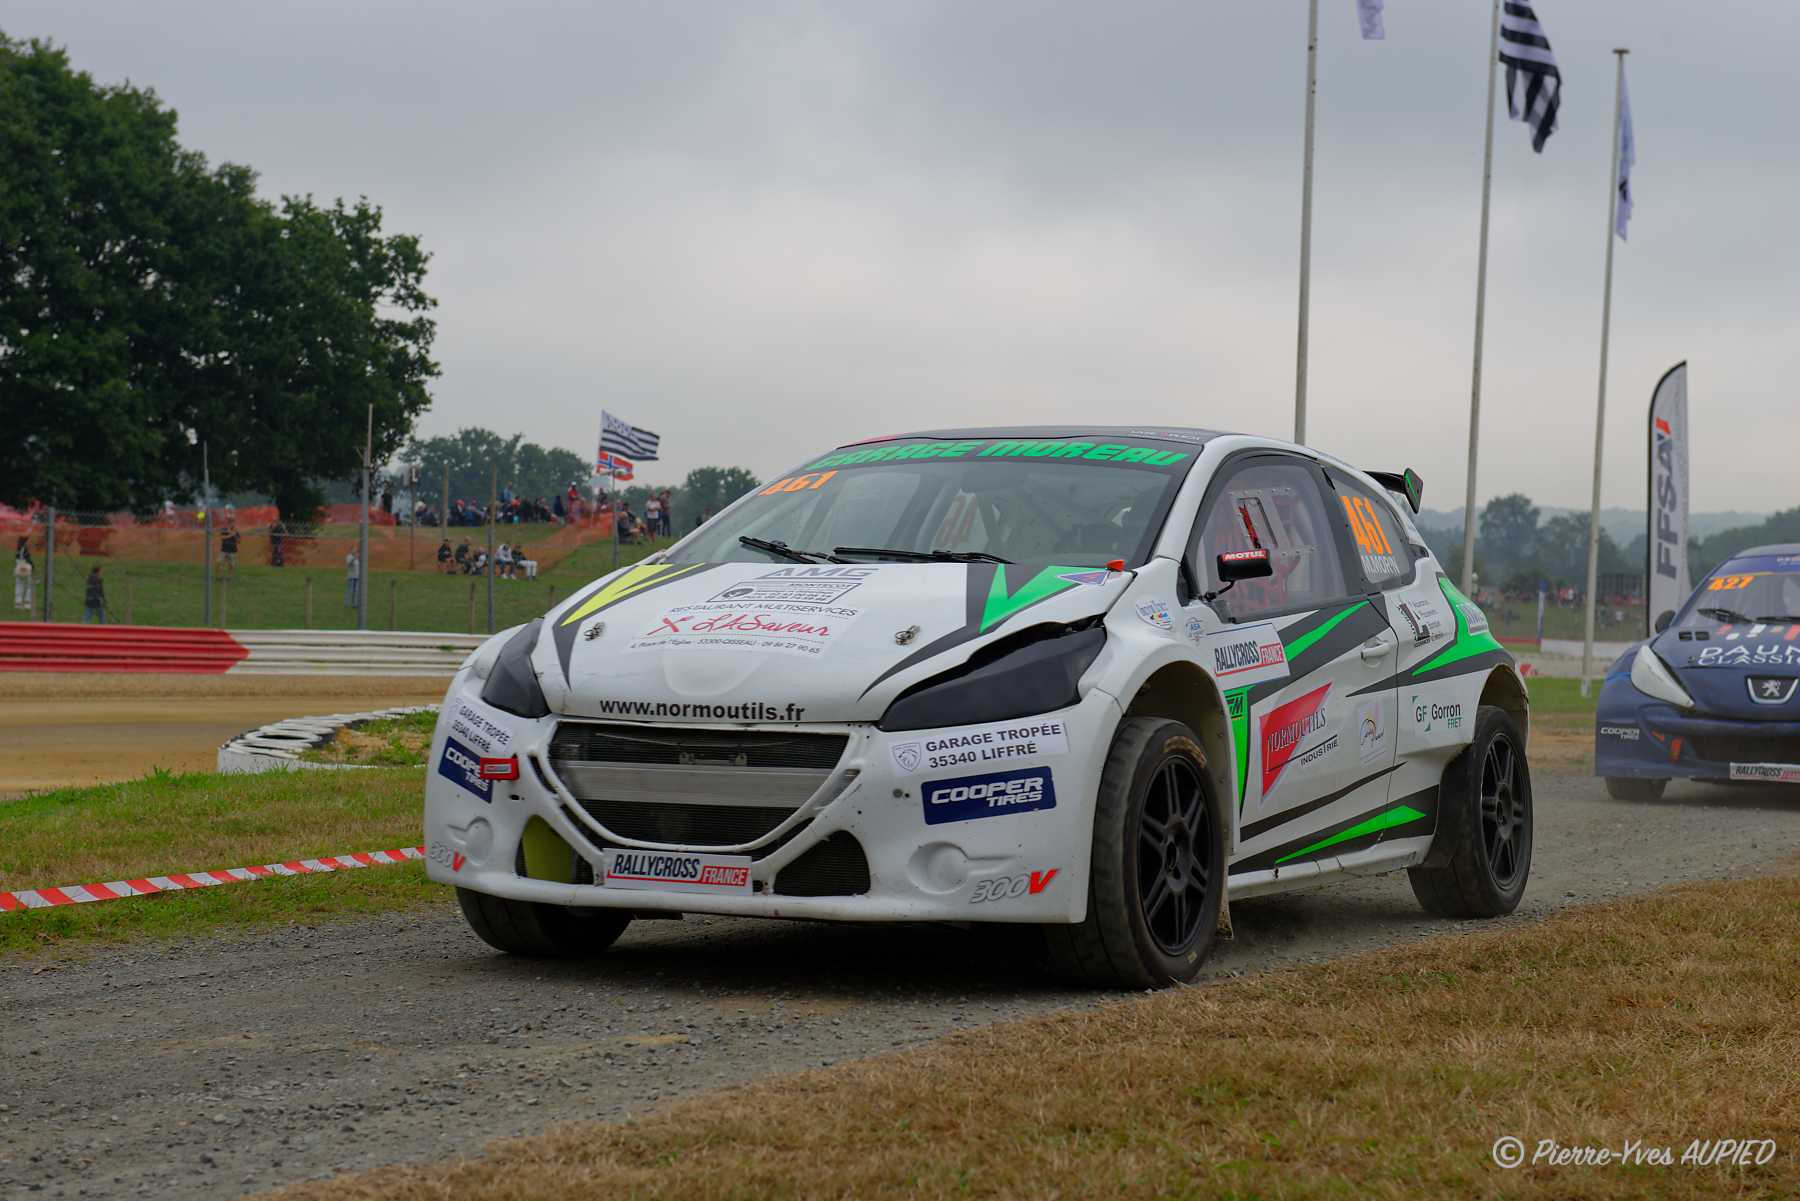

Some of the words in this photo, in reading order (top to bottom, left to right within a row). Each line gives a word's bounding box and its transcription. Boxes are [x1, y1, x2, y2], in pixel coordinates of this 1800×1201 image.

[806, 442, 980, 470] GARAGE
[978, 442, 1188, 467] MOREAU
[1656, 438, 1678, 580] FFSA
[1224, 551, 1265, 560] MOTUL
[759, 567, 880, 578] AMG
[755, 603, 858, 617] MULTISERVICES
[1214, 642, 1259, 672] RALLYCROSS
[1261, 645, 1284, 664] FRANCE
[1698, 655, 1800, 665] CLASSI
[599, 698, 805, 722] www.normoutils.fr
[1415, 706, 1427, 722] GF
[1431, 703, 1461, 721] Gorron
[1448, 718, 1461, 729] FRET
[925, 732, 993, 753] GARAGE
[997, 722, 1062, 742] TROPÉE
[1267, 708, 1327, 753] NORMOUTILS
[1600, 727, 1640, 736] COOPER
[446, 747, 490, 783] COOPE
[928, 752, 977, 769] 35340
[981, 742, 1038, 761] LIFFRÉ
[1301, 738, 1339, 767] INDUSTRIE
[931, 777, 1045, 805] COOPER
[988, 791, 1043, 808] TIRES
[612, 853, 700, 879] RALLYCROSS
[703, 866, 748, 887] FRANCE
[969, 868, 1062, 904] 300V
